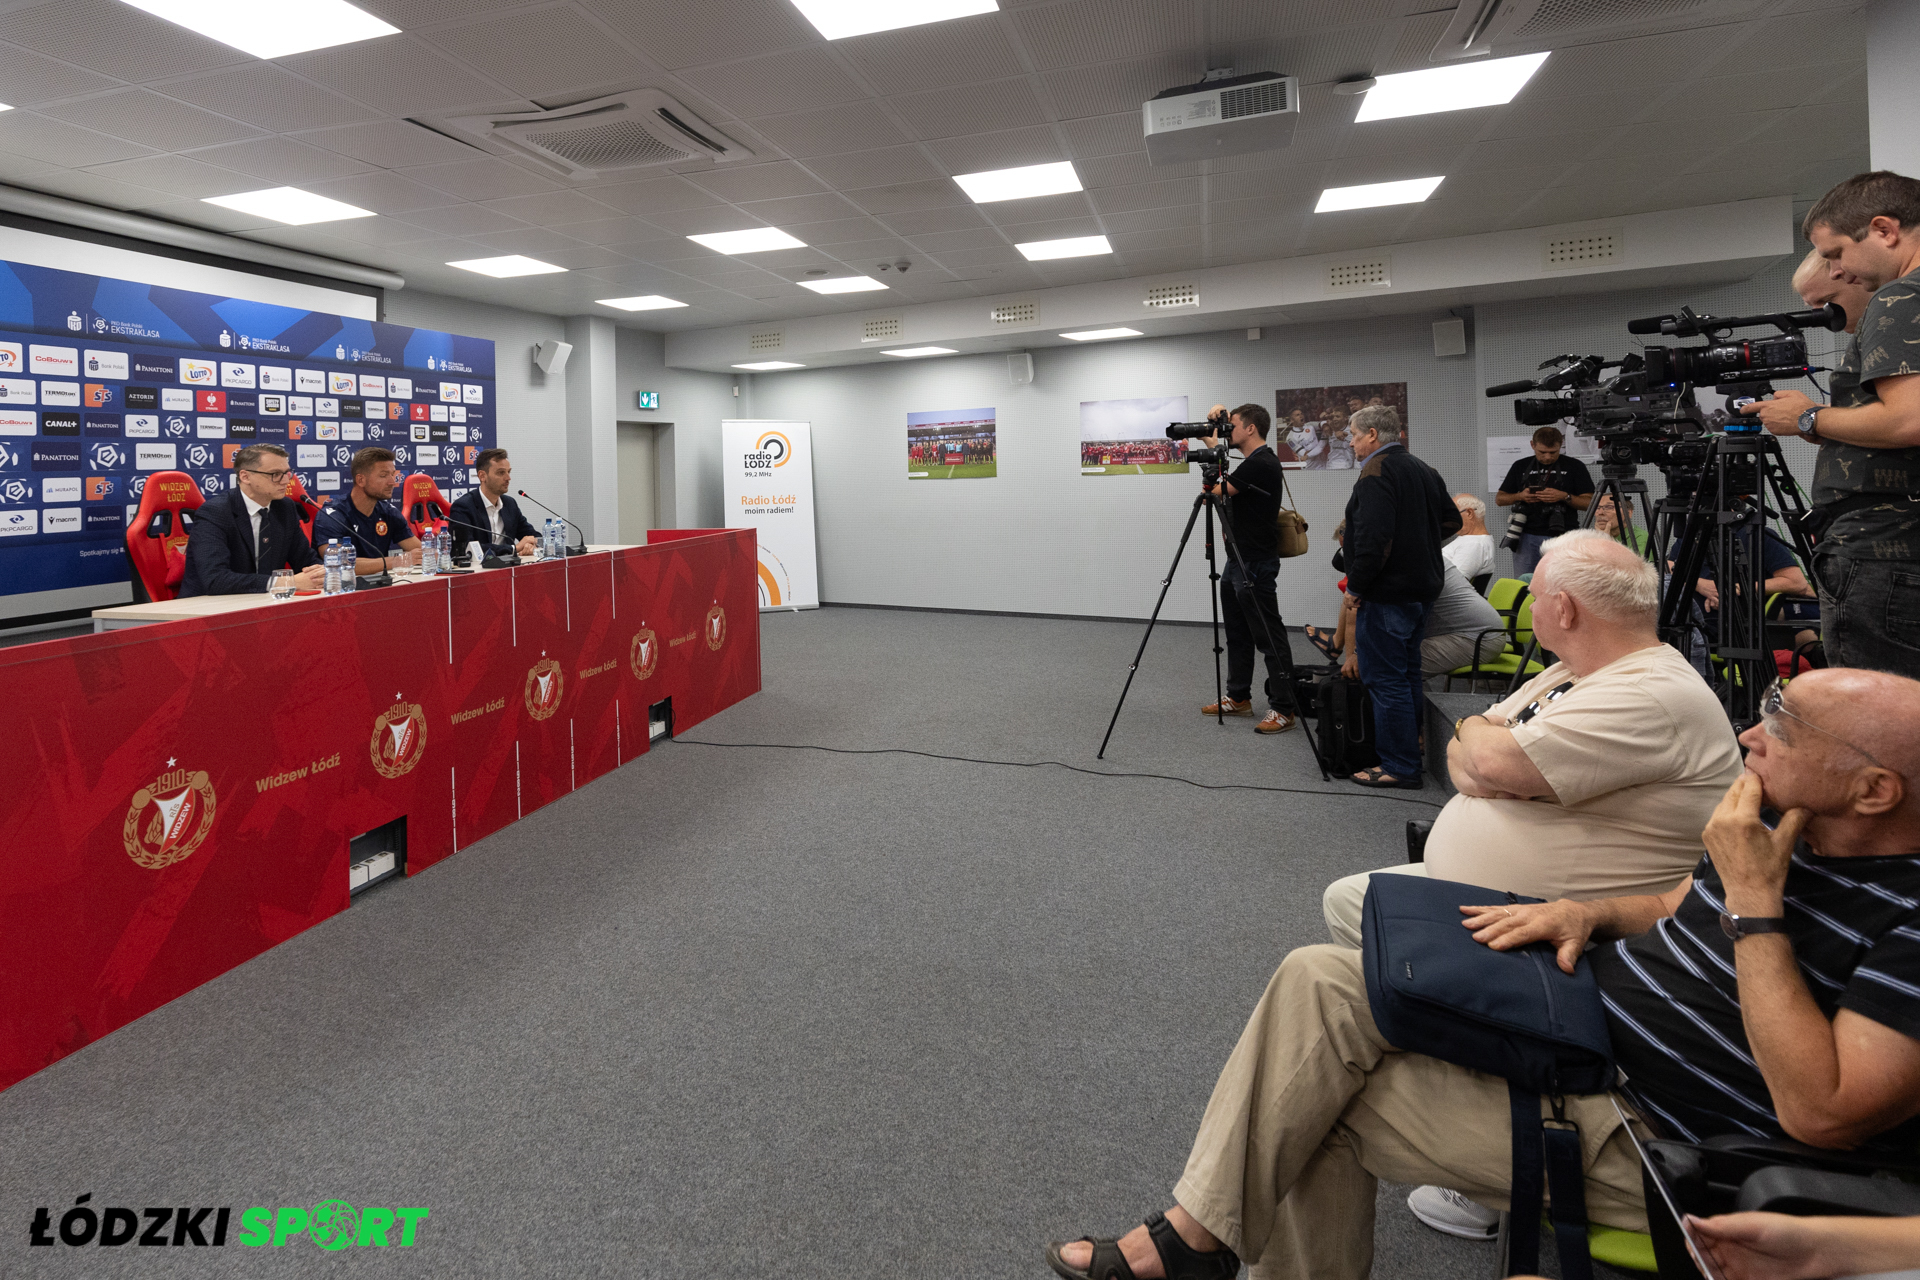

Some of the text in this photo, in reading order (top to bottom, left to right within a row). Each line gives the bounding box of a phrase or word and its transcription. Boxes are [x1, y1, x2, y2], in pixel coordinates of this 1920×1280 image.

[111, 326, 160, 338] EKSTRAKLASA
[252, 342, 290, 352] EKSTRAKLASA
[362, 356, 391, 364] EKSTRAKLASA
[142, 365, 173, 373] PANATTONI
[190, 370, 207, 378] LOTTO
[448, 365, 472, 373] EKSTRAKLASA
[94, 389, 112, 402] STS
[394, 406, 404, 416] STS
[295, 424, 308, 435] STS
[744, 452, 771, 460] radio
[745, 460, 771, 468] ŁÓDŹ
[95, 481, 114, 495] STS
[160, 483, 191, 491] WIDZEW
[167, 492, 186, 502] ŁÓDŹ
[741, 494, 796, 505] Radio Łódź
[767, 506, 794, 514] radiem!
[80, 548, 110, 557] Spotkajmy
[669, 637, 686, 647] Widzew
[579, 658, 617, 680] Widzew Łódź
[390, 701, 408, 719] 1910
[450, 697, 505, 725] Widzew Łódź
[399, 728, 412, 756] WIDZEW
[256, 752, 341, 793] Widzew Łódź
[157, 768, 185, 792] 1910
[169, 803, 180, 818] RTS
[170, 803, 191, 839] WIDZEW
